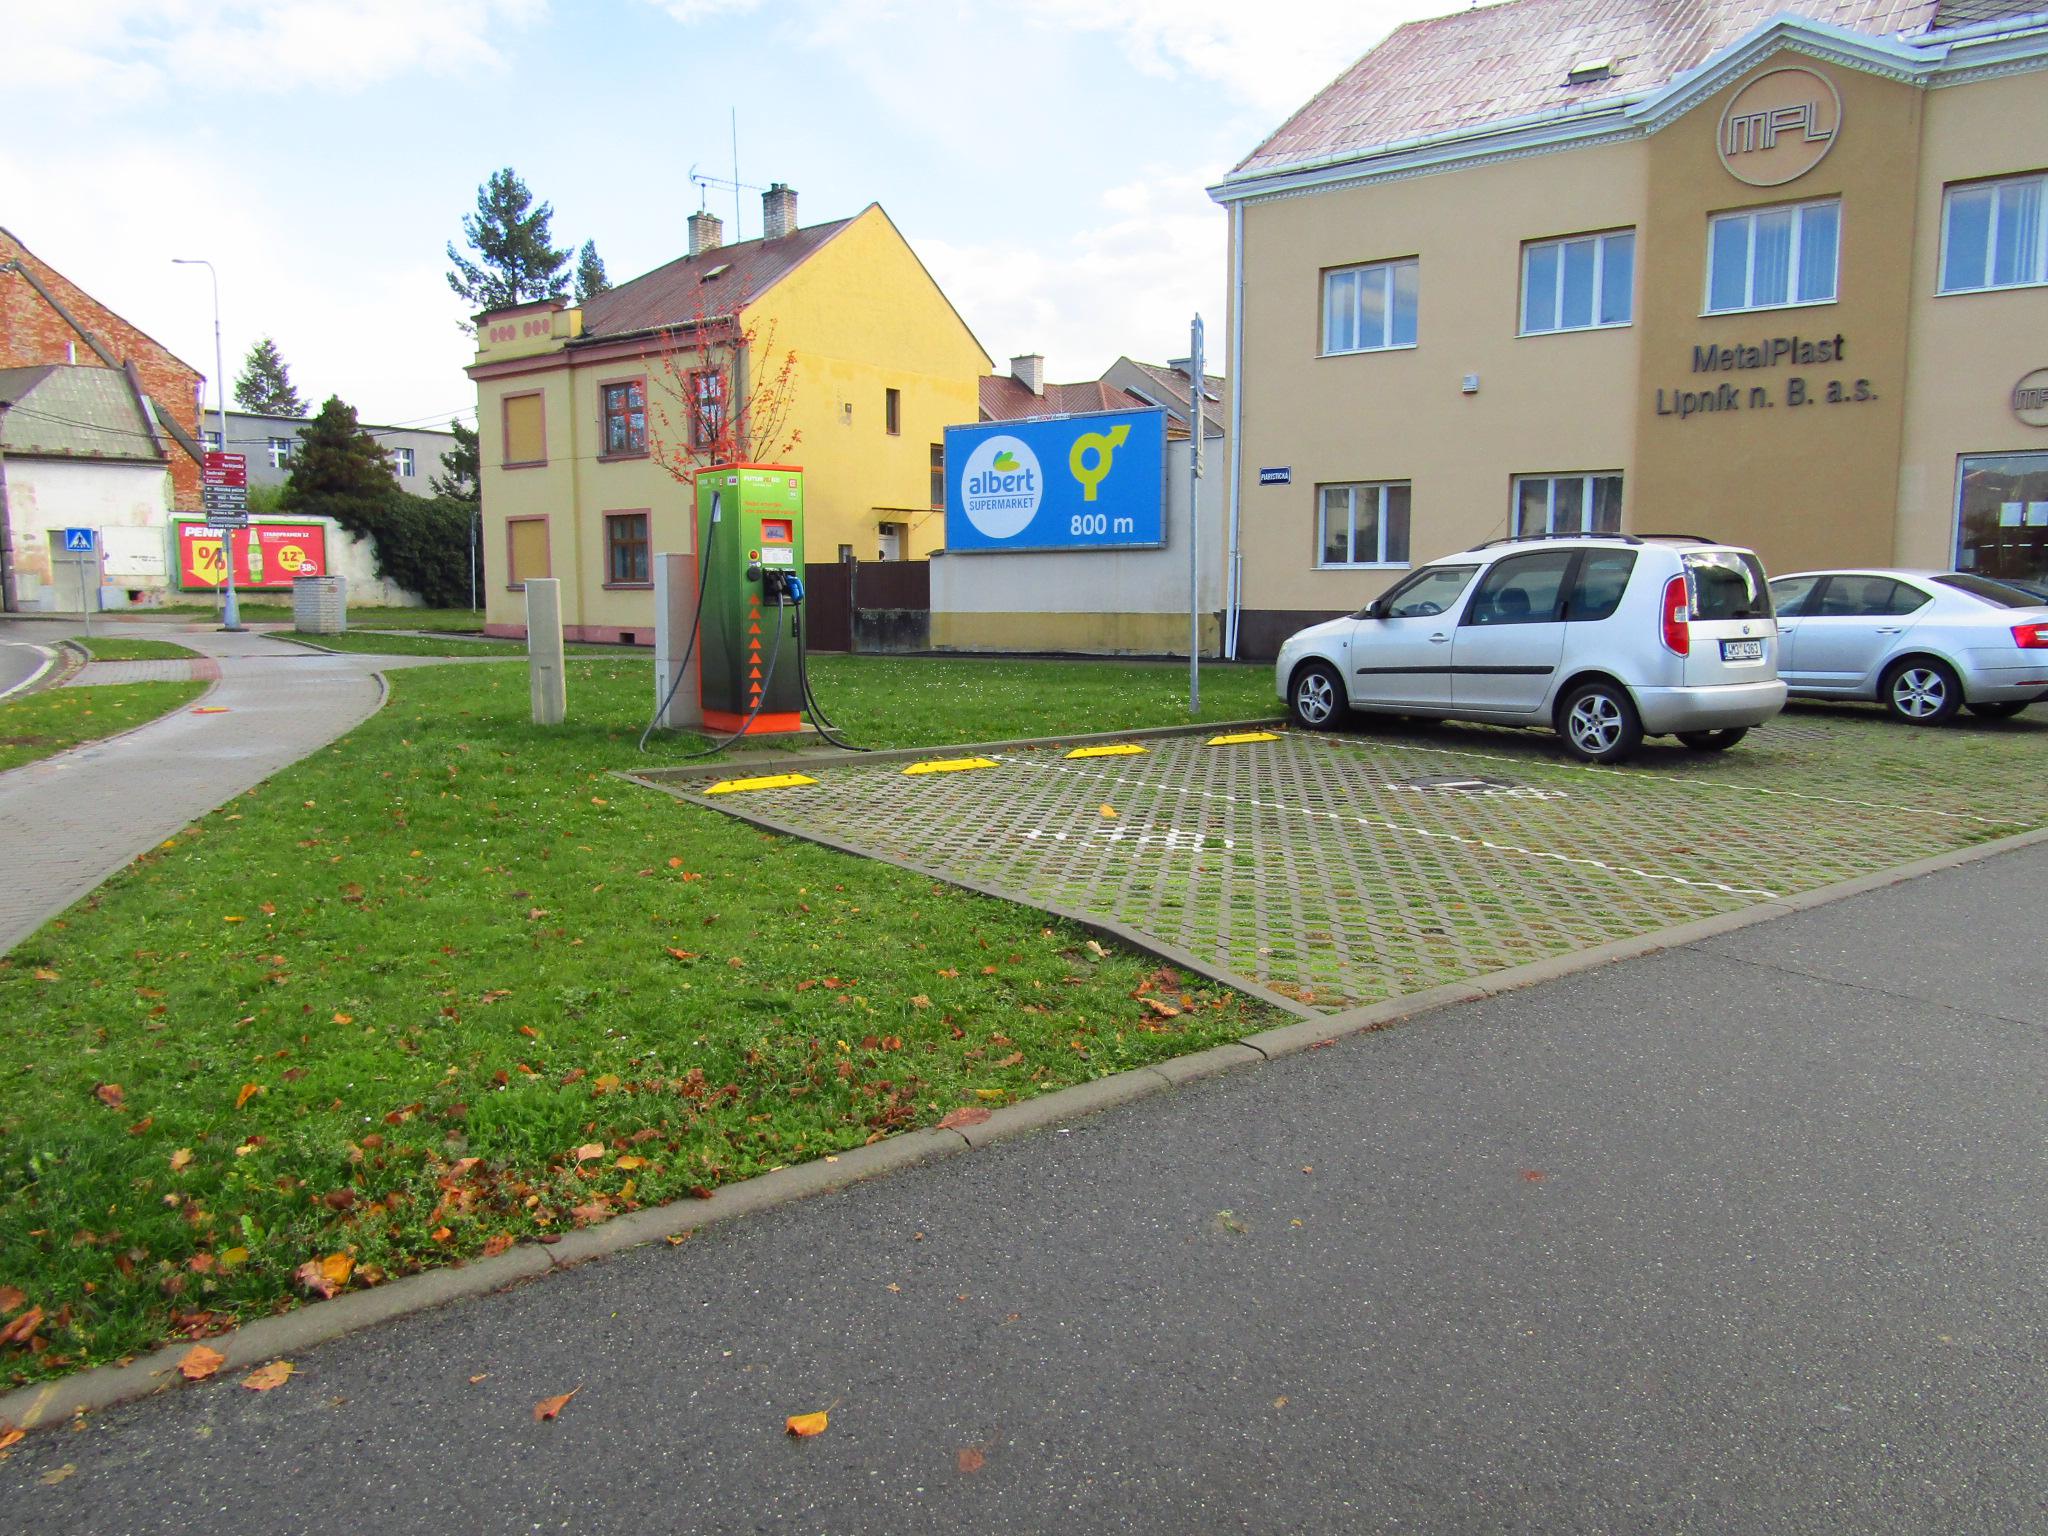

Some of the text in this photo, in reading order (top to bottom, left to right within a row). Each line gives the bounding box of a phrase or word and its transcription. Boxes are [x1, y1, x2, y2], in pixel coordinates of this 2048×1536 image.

[1727, 101, 1833, 155] MPL
[1692, 333, 1844, 373] MetalPlast
[1748, 385, 1774, 409] n.
[1787, 378, 1814, 406] B.
[1826, 378, 1879, 402] a.s.
[969, 468, 1034, 494] albert
[969, 498, 1034, 511] SUPERMARKET
[1070, 514, 1134, 535] 800 m
